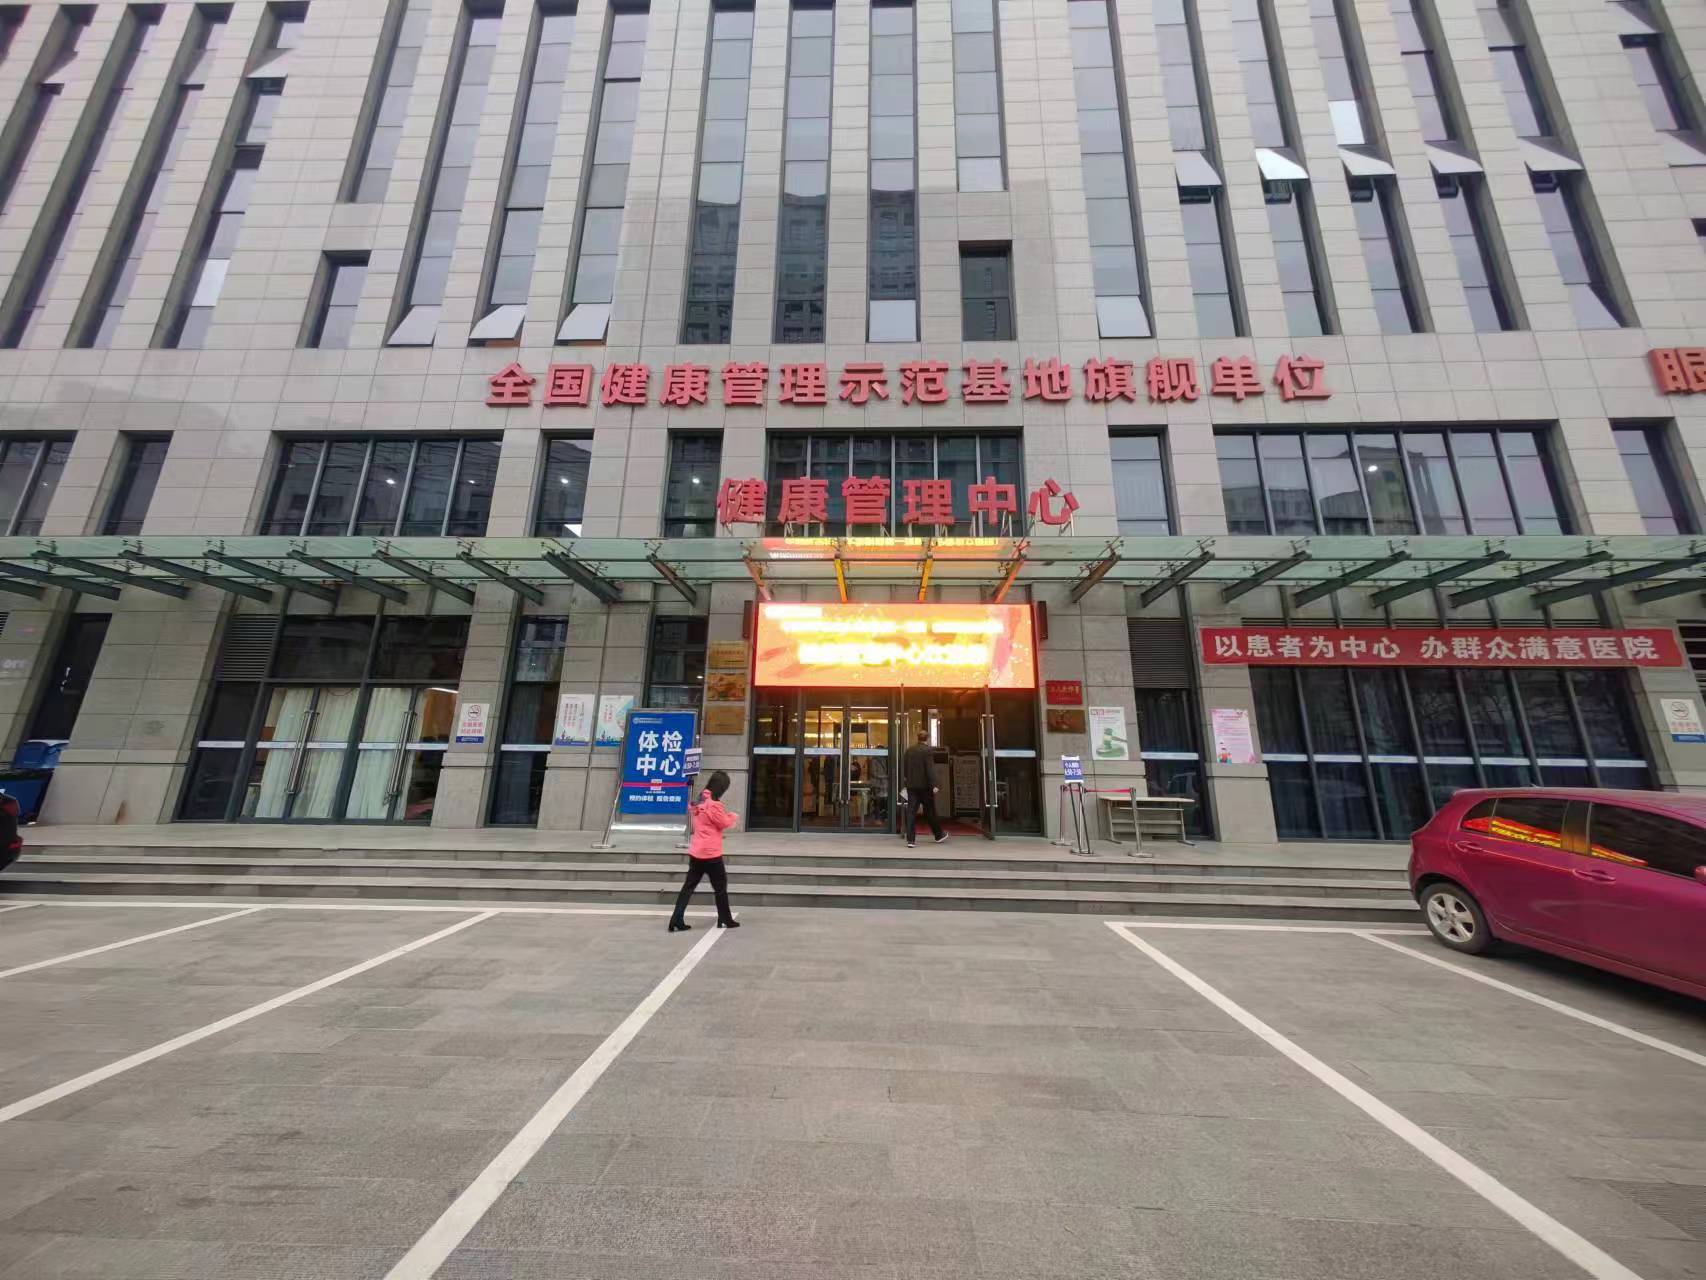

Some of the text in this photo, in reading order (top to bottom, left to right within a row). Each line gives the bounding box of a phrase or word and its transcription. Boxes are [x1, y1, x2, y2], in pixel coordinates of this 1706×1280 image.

[486, 355, 1332, 409] 全国健康管理示范基地旗舰单位
[716, 476, 1080, 526] 健康管理中心
[1215, 635, 1660, 660] 以患者为中心 办群众满意医院
[638, 730, 683, 753] 体检
[636, 753, 681, 776] 中心
